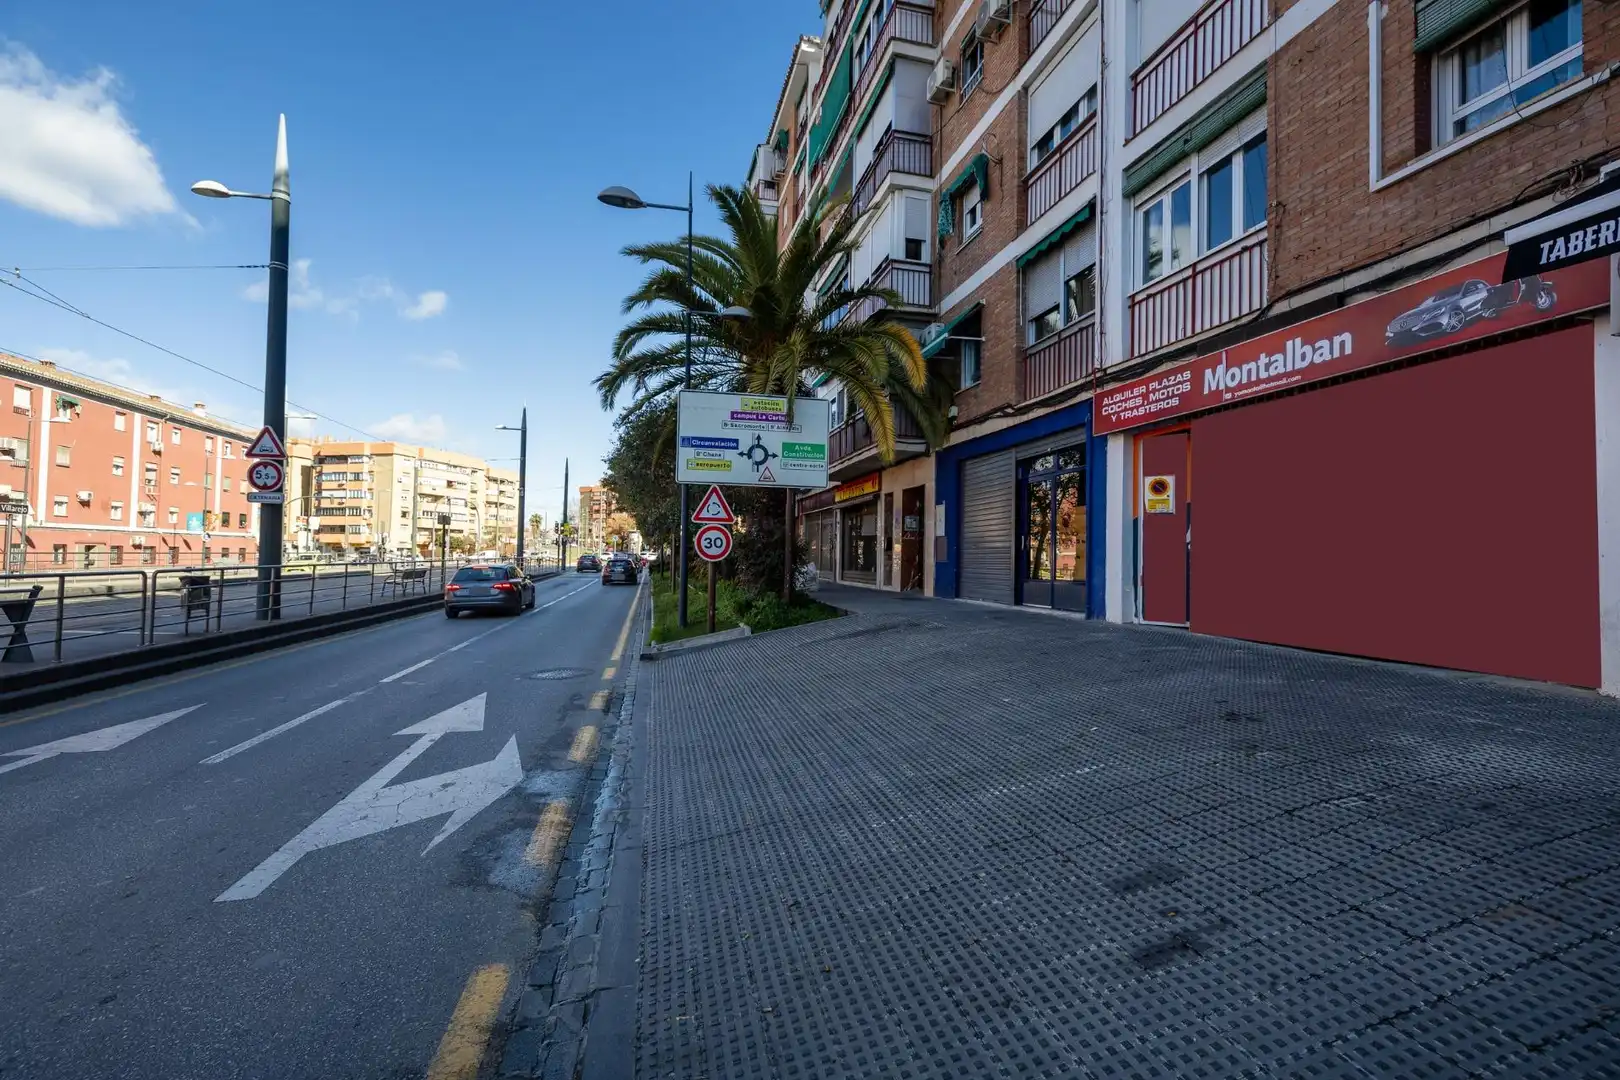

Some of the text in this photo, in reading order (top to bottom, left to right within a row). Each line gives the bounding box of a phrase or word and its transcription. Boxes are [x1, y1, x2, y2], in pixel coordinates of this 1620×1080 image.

[1539, 217, 1620, 265] TABER
[1203, 331, 1352, 395] Montalban
[1102, 370, 1191, 406] ALQUILER PLAZAS
[1149, 382, 1191, 403] MOTOS
[1111, 397, 1179, 422] Y TRASTEROS
[692, 439, 737, 448] Circunvalación
[784, 451, 824, 459] Constitución
[1, 504, 27, 513] Villarejo
[703, 537, 724, 549] 30
